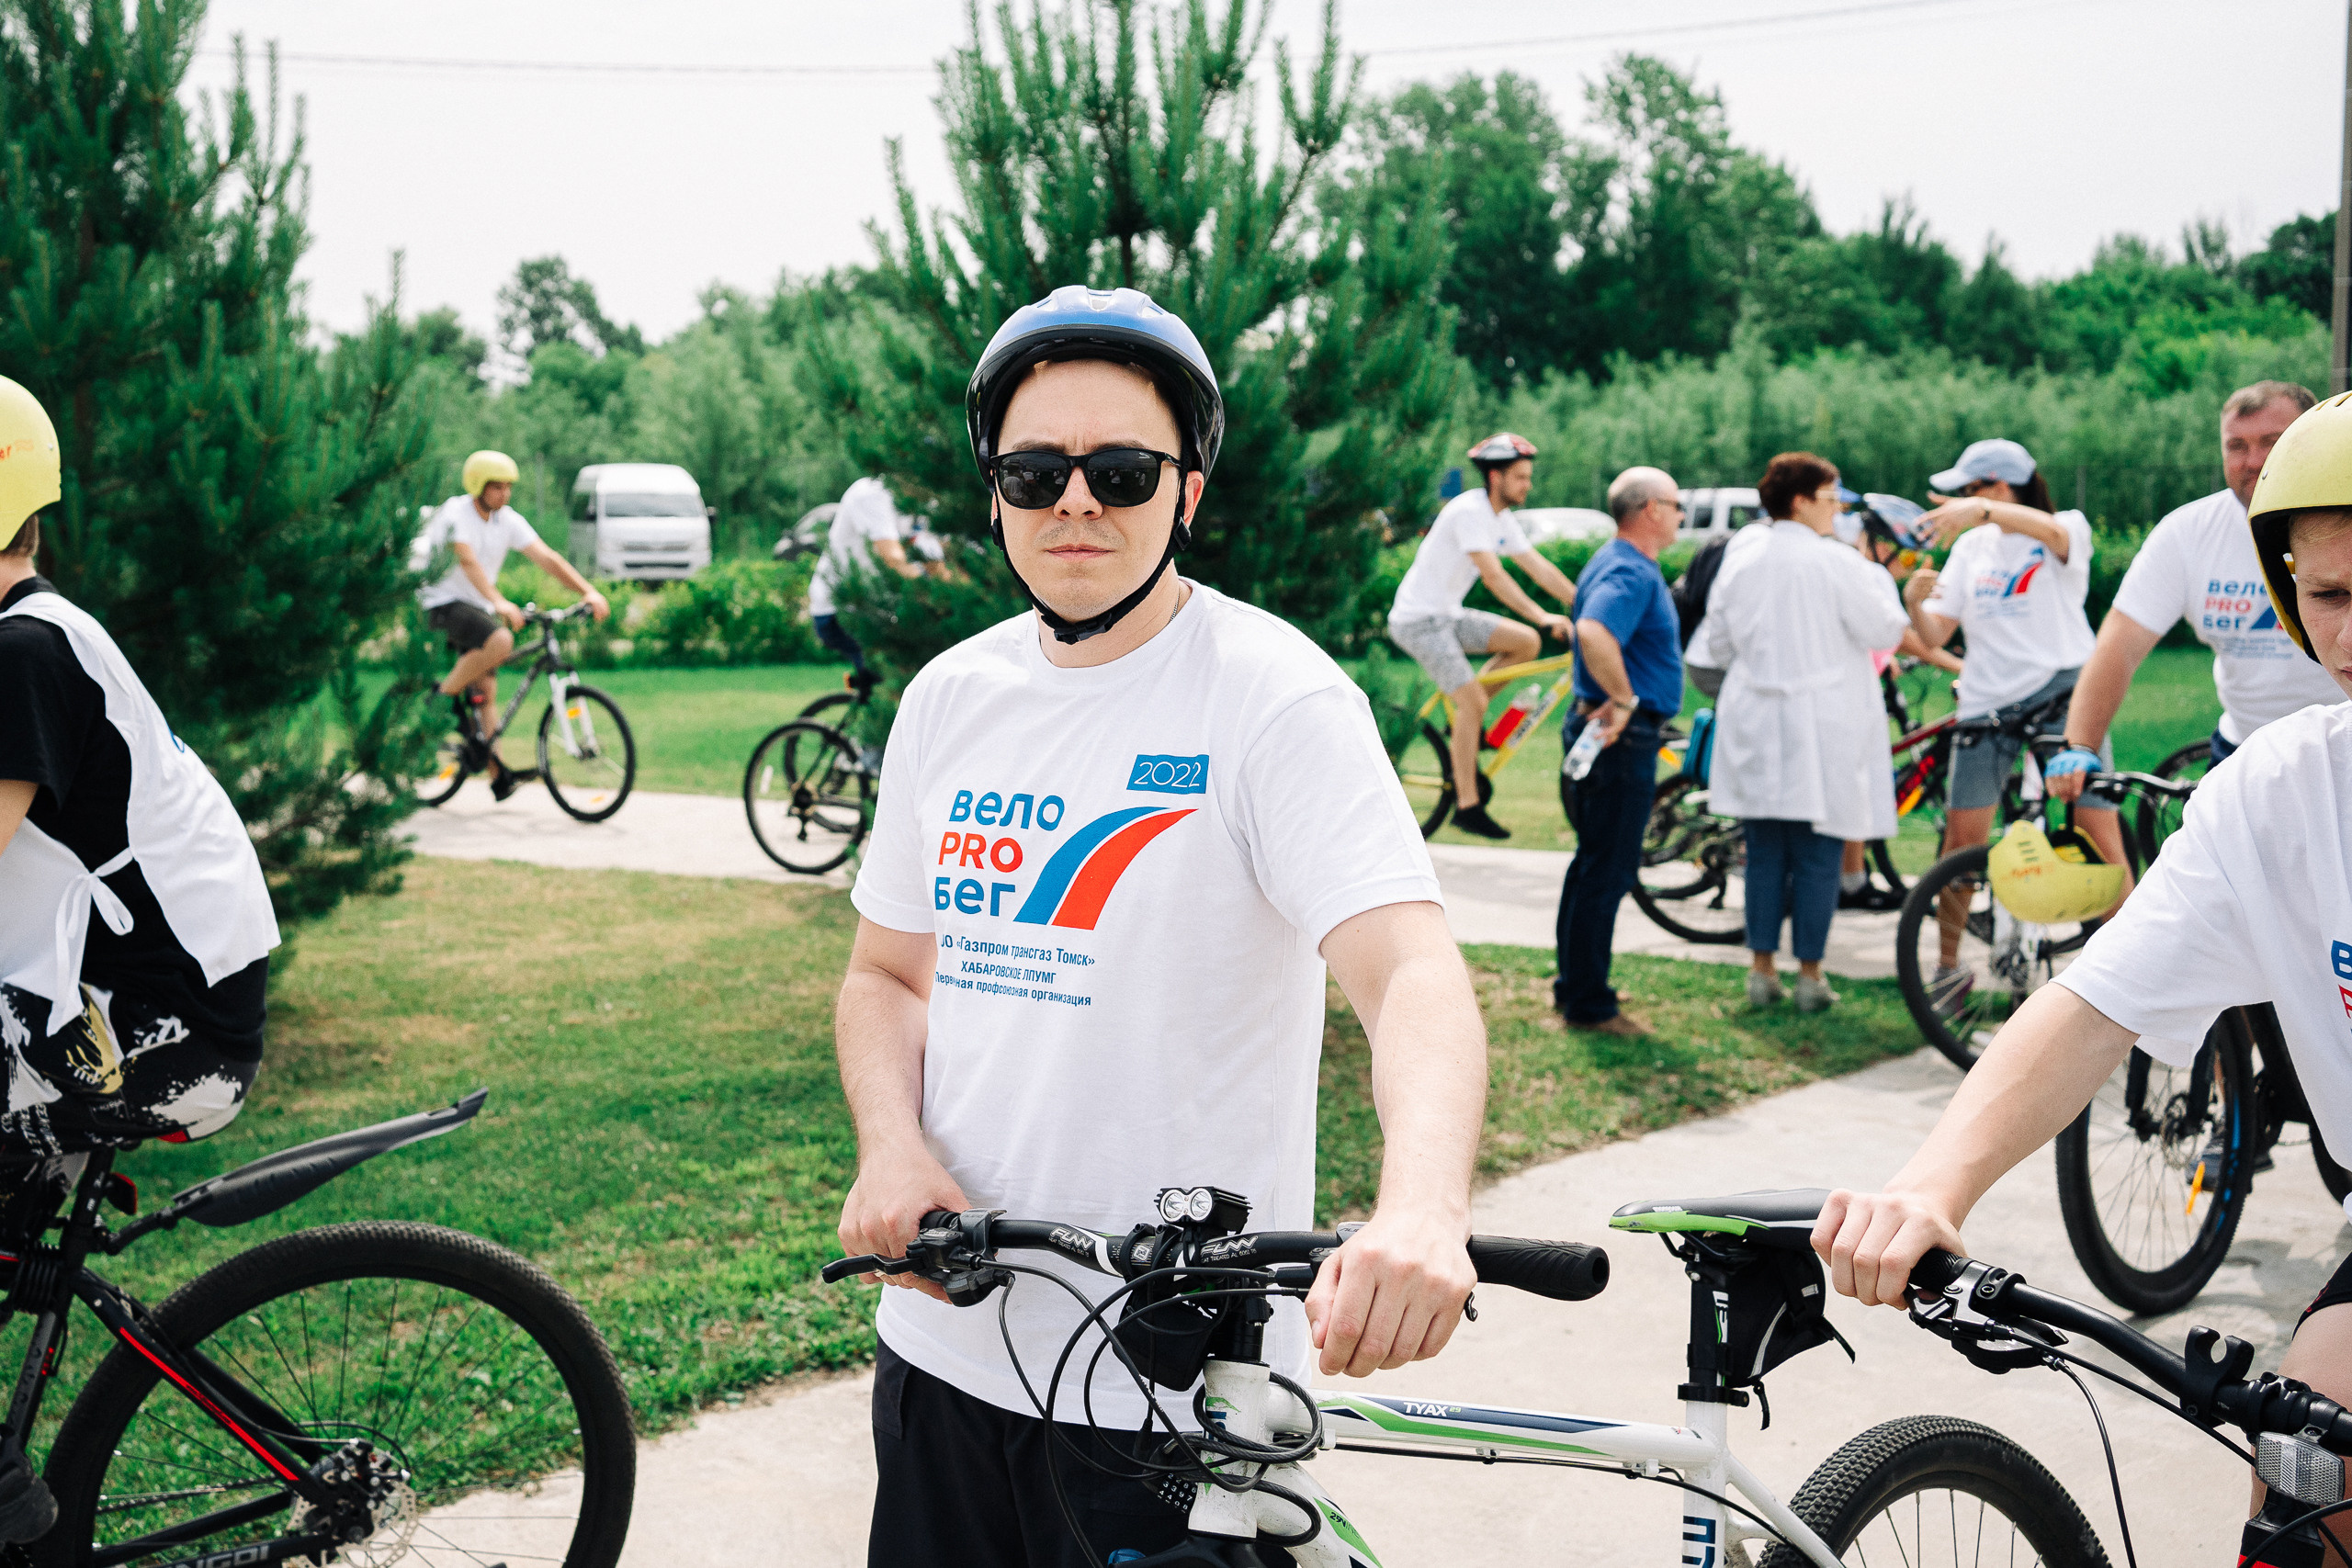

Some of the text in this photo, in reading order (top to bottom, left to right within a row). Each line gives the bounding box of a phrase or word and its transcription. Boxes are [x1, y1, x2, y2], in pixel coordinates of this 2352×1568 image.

[1134, 761, 1202, 788] 2022
[938, 831, 1023, 873] PRO
[956, 936, 1009, 957] «Газпром
[1011, 945, 1052, 962] трансгаз
[1057, 948, 1095, 966] Томск»
[961, 960, 1057, 984] ХАБАРОВСКОЕ ЛПУМГ
[935, 971, 1091, 1007] Первная профсоюзная организация
[1403, 1402, 1449, 1416] TYAX
